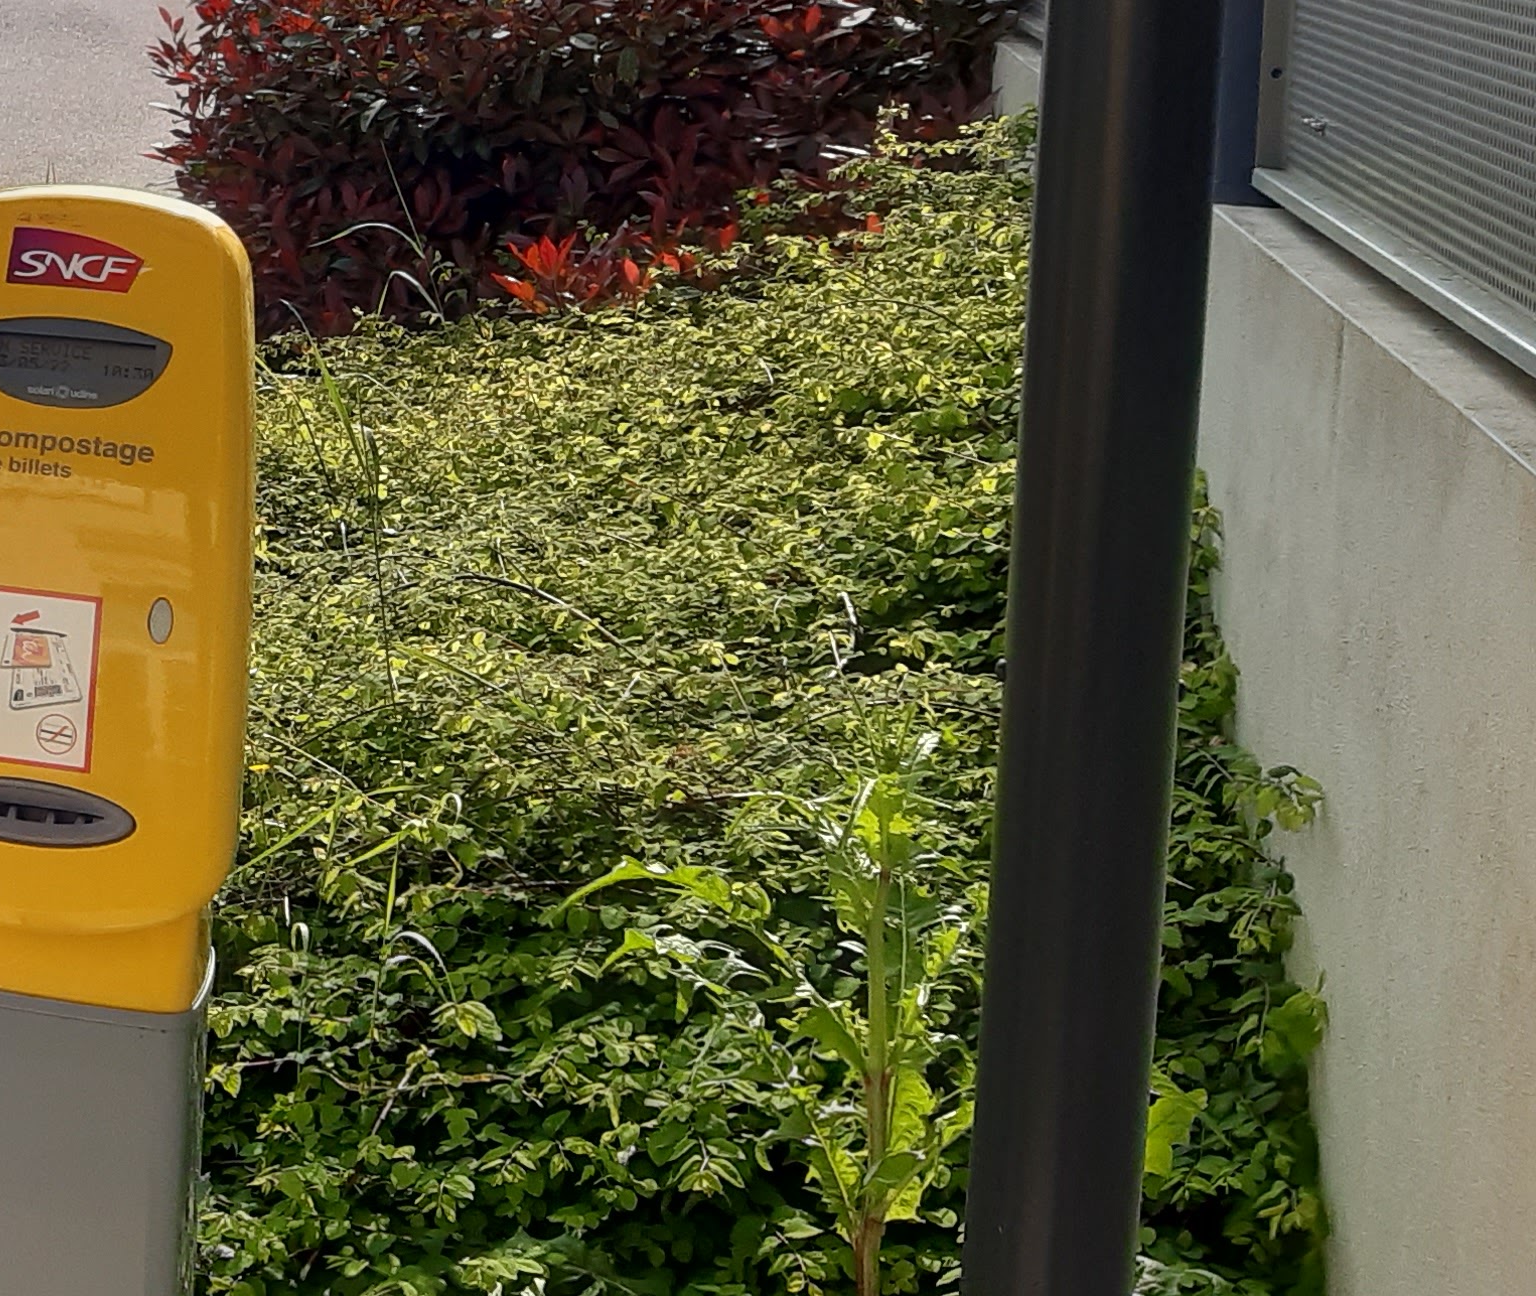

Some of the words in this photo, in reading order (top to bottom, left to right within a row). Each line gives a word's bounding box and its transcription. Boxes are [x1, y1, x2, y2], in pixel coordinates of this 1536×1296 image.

[13, 250, 137, 283] SNCF
[21, 340, 94, 361] SERVICE
[28, 385, 55, 396] solari
[8, 455, 73, 479] billets
